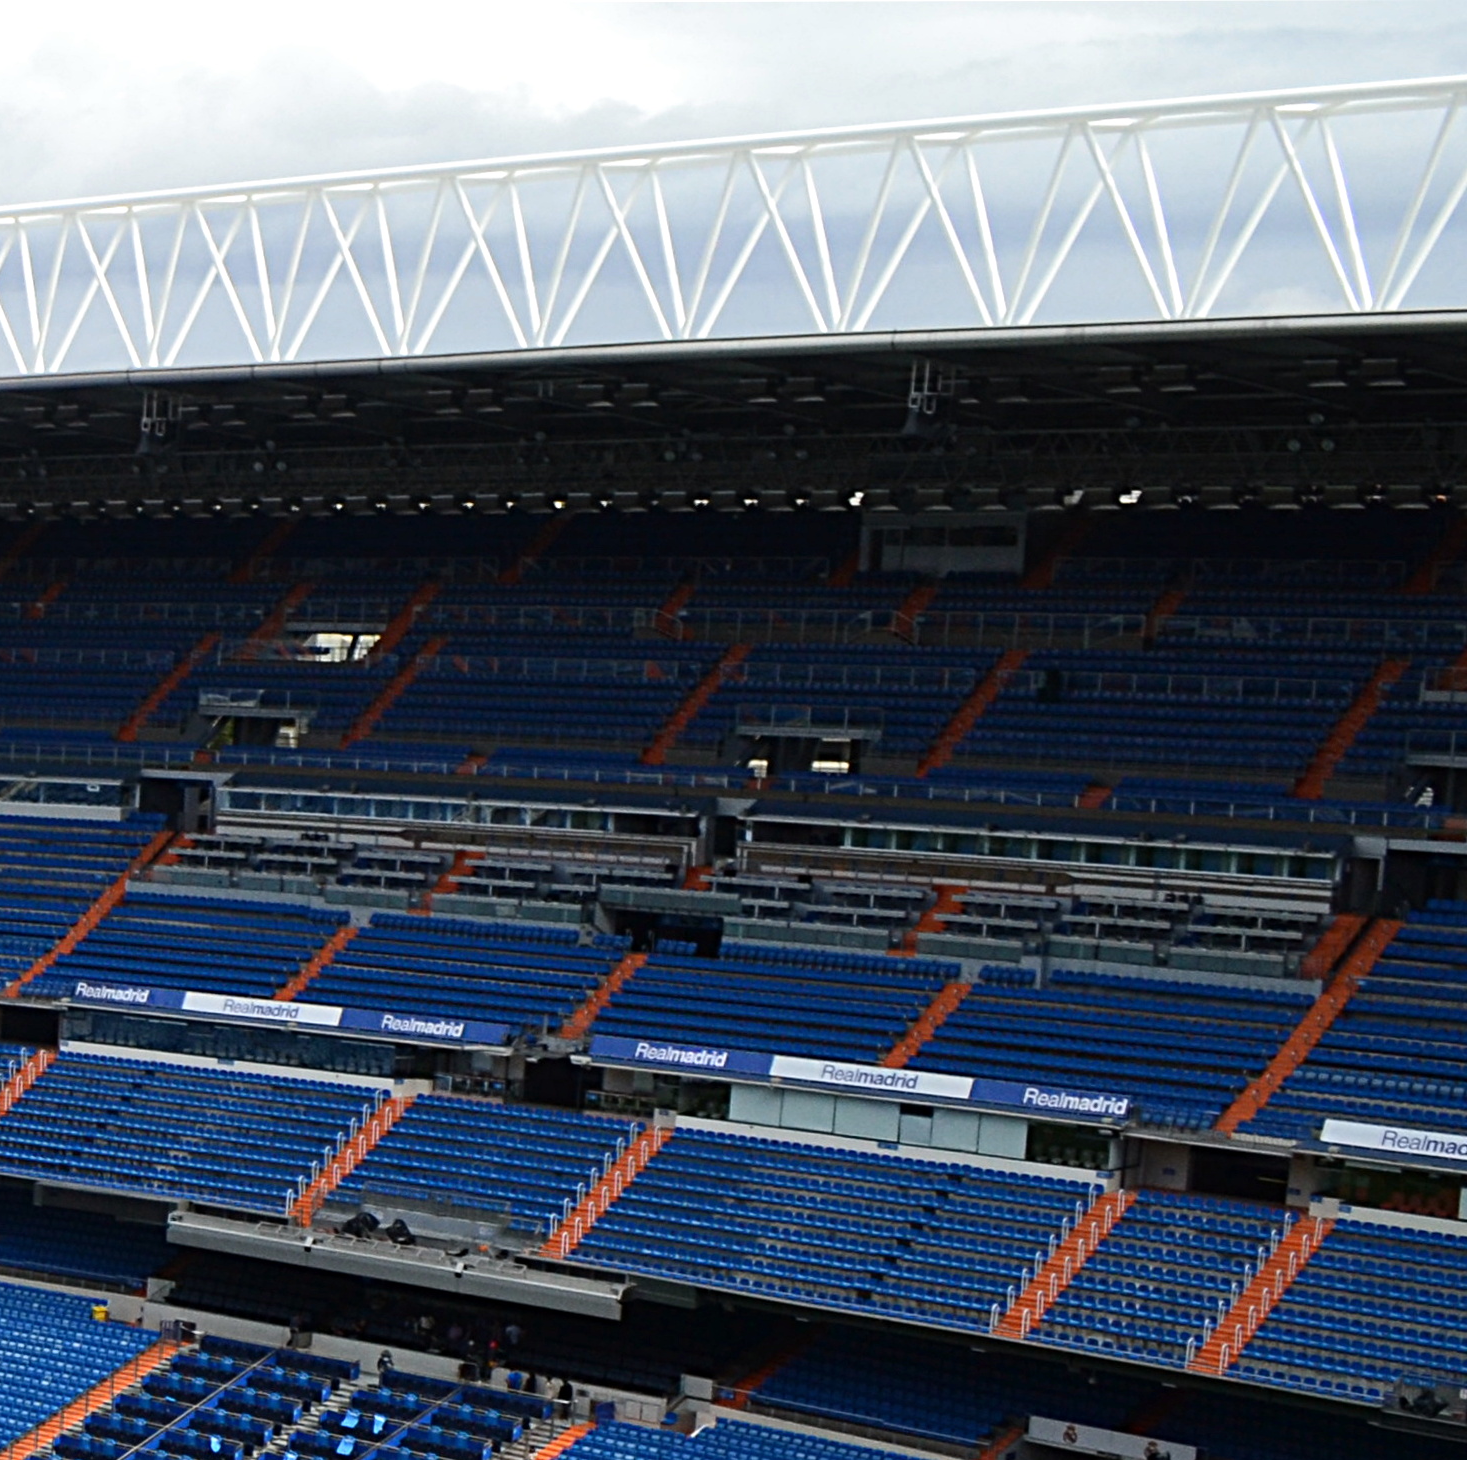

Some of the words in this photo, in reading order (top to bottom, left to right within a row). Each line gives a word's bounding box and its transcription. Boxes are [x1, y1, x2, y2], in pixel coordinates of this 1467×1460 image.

[75, 983, 149, 1004] Realmadrid
[223, 999, 299, 1019] Realmadrid
[381, 1014, 464, 1038] Realmadrid
[634, 1042, 727, 1068] Realmadrid
[821, 1063, 918, 1089] Realmadrid
[1023, 1087, 1128, 1114] Realmadrid
